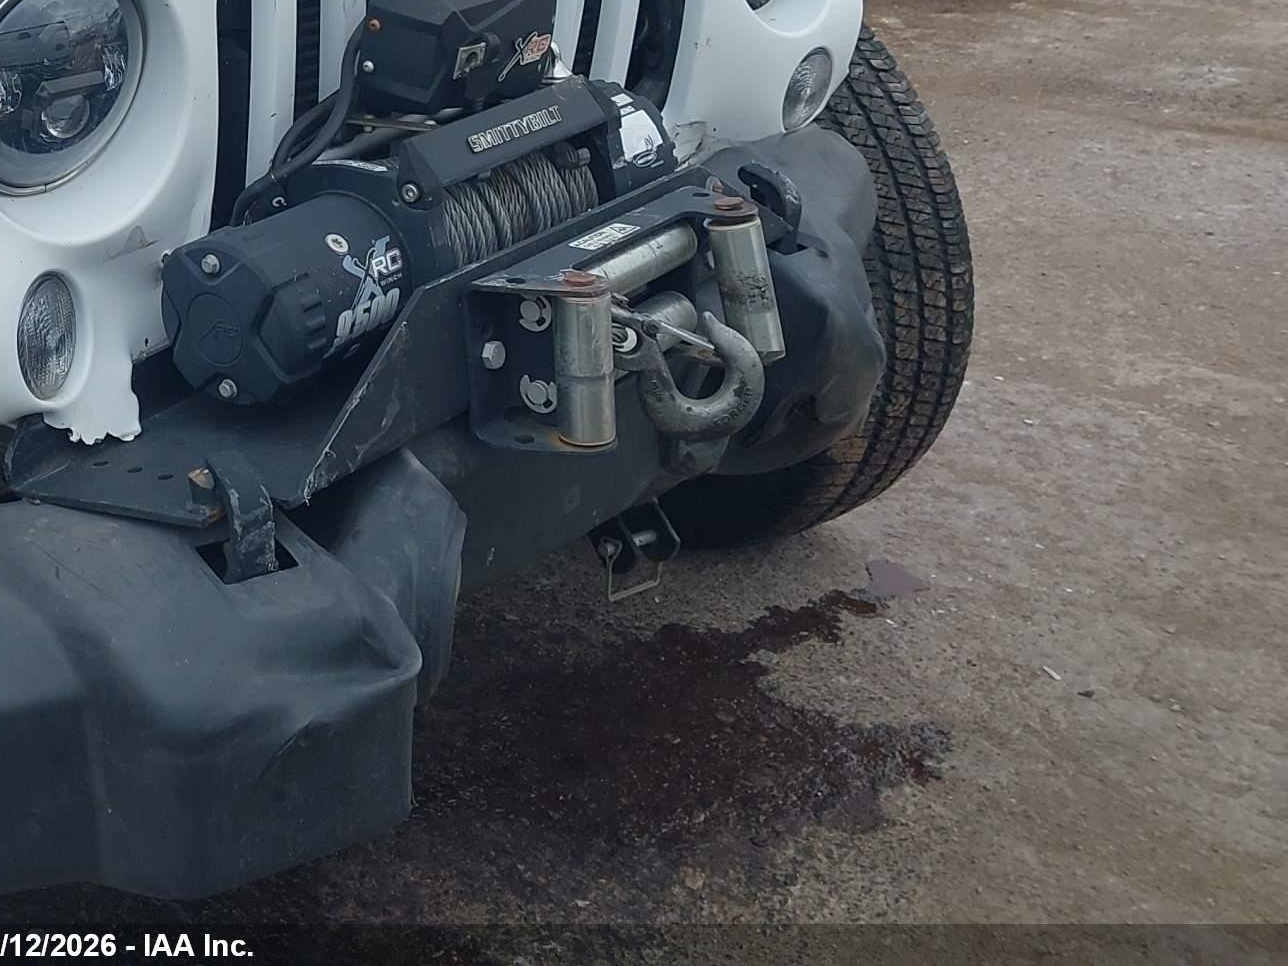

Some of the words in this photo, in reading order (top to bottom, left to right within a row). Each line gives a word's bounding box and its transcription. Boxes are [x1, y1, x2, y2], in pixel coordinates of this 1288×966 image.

[467, 105, 562, 153] SMITTYBILT
[380, 272, 403, 288] WINCH
[326, 287, 400, 352] 9500
